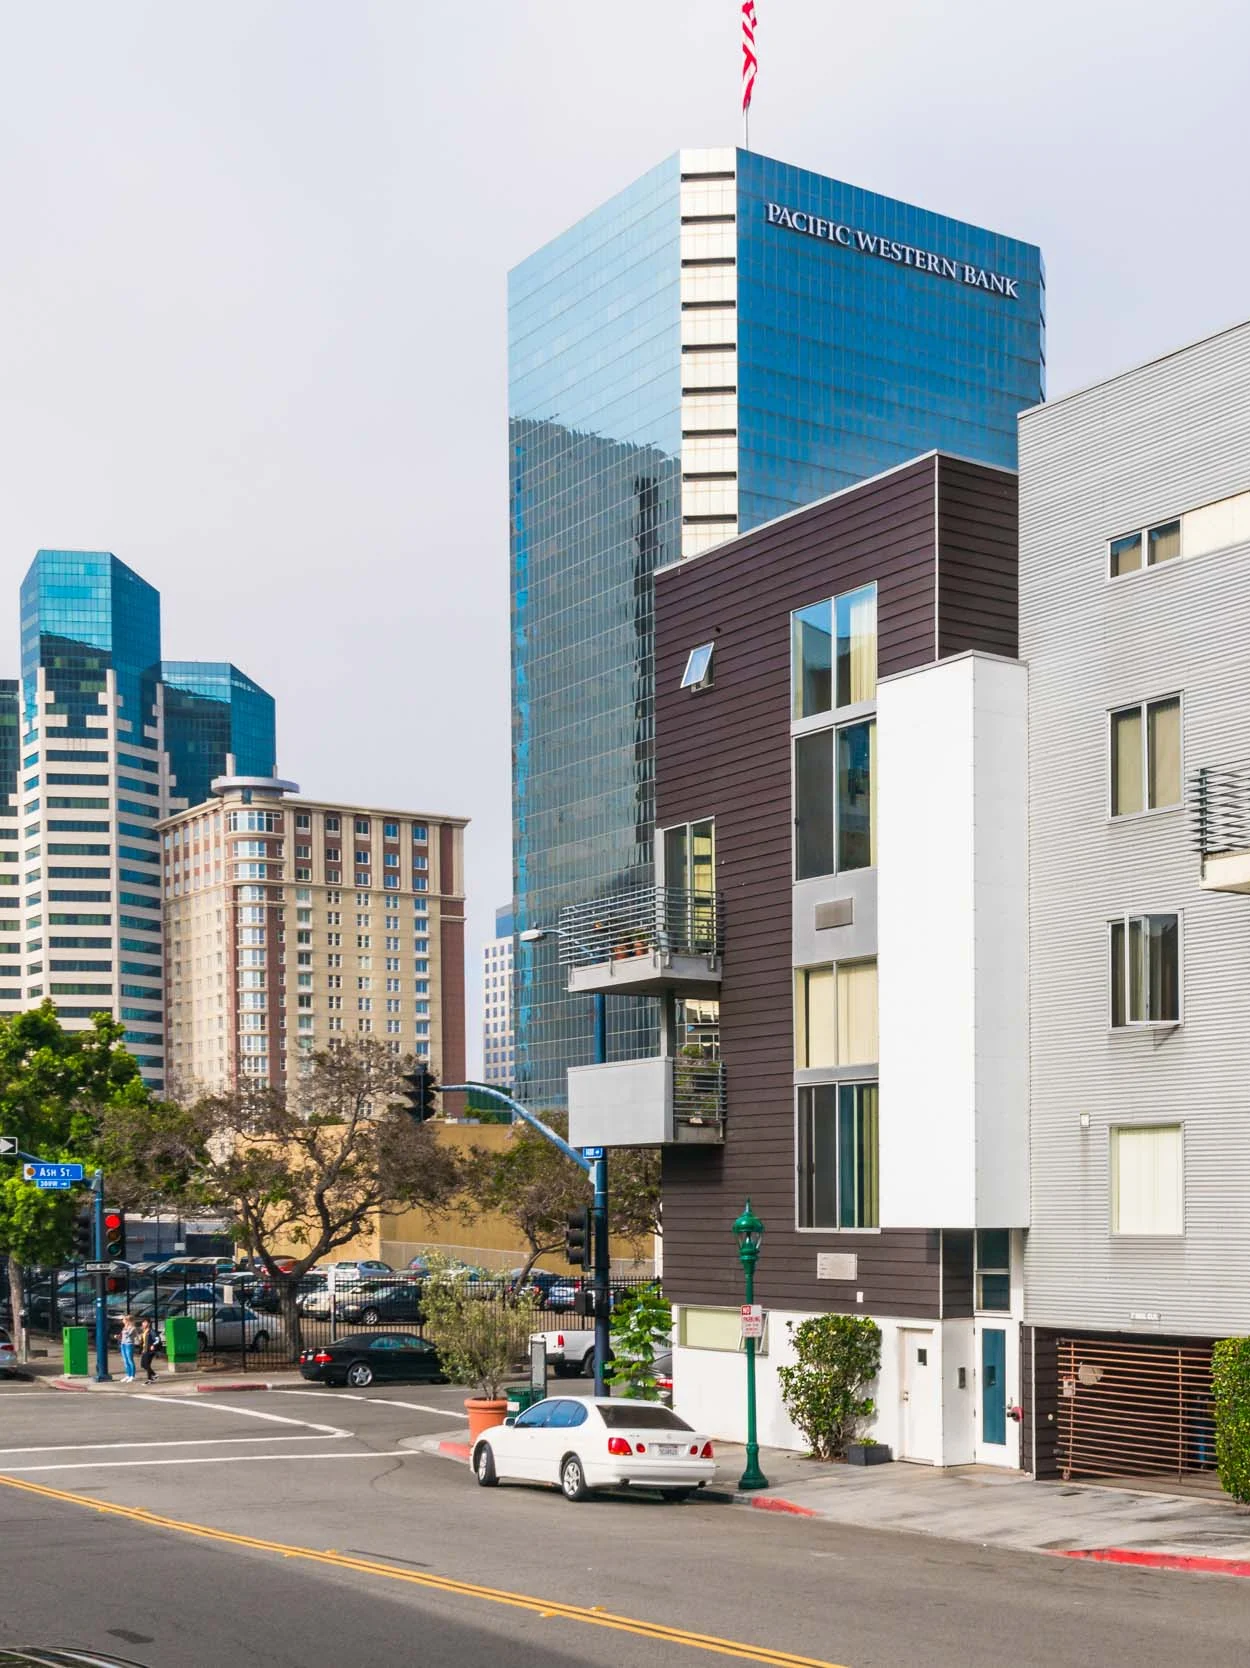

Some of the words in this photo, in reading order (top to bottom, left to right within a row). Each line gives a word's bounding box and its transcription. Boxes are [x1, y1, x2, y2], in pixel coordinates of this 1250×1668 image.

[767, 202, 850, 245] PACIFIC
[856, 231, 957, 279] WESTERN
[964, 264, 1019, 299] BANK
